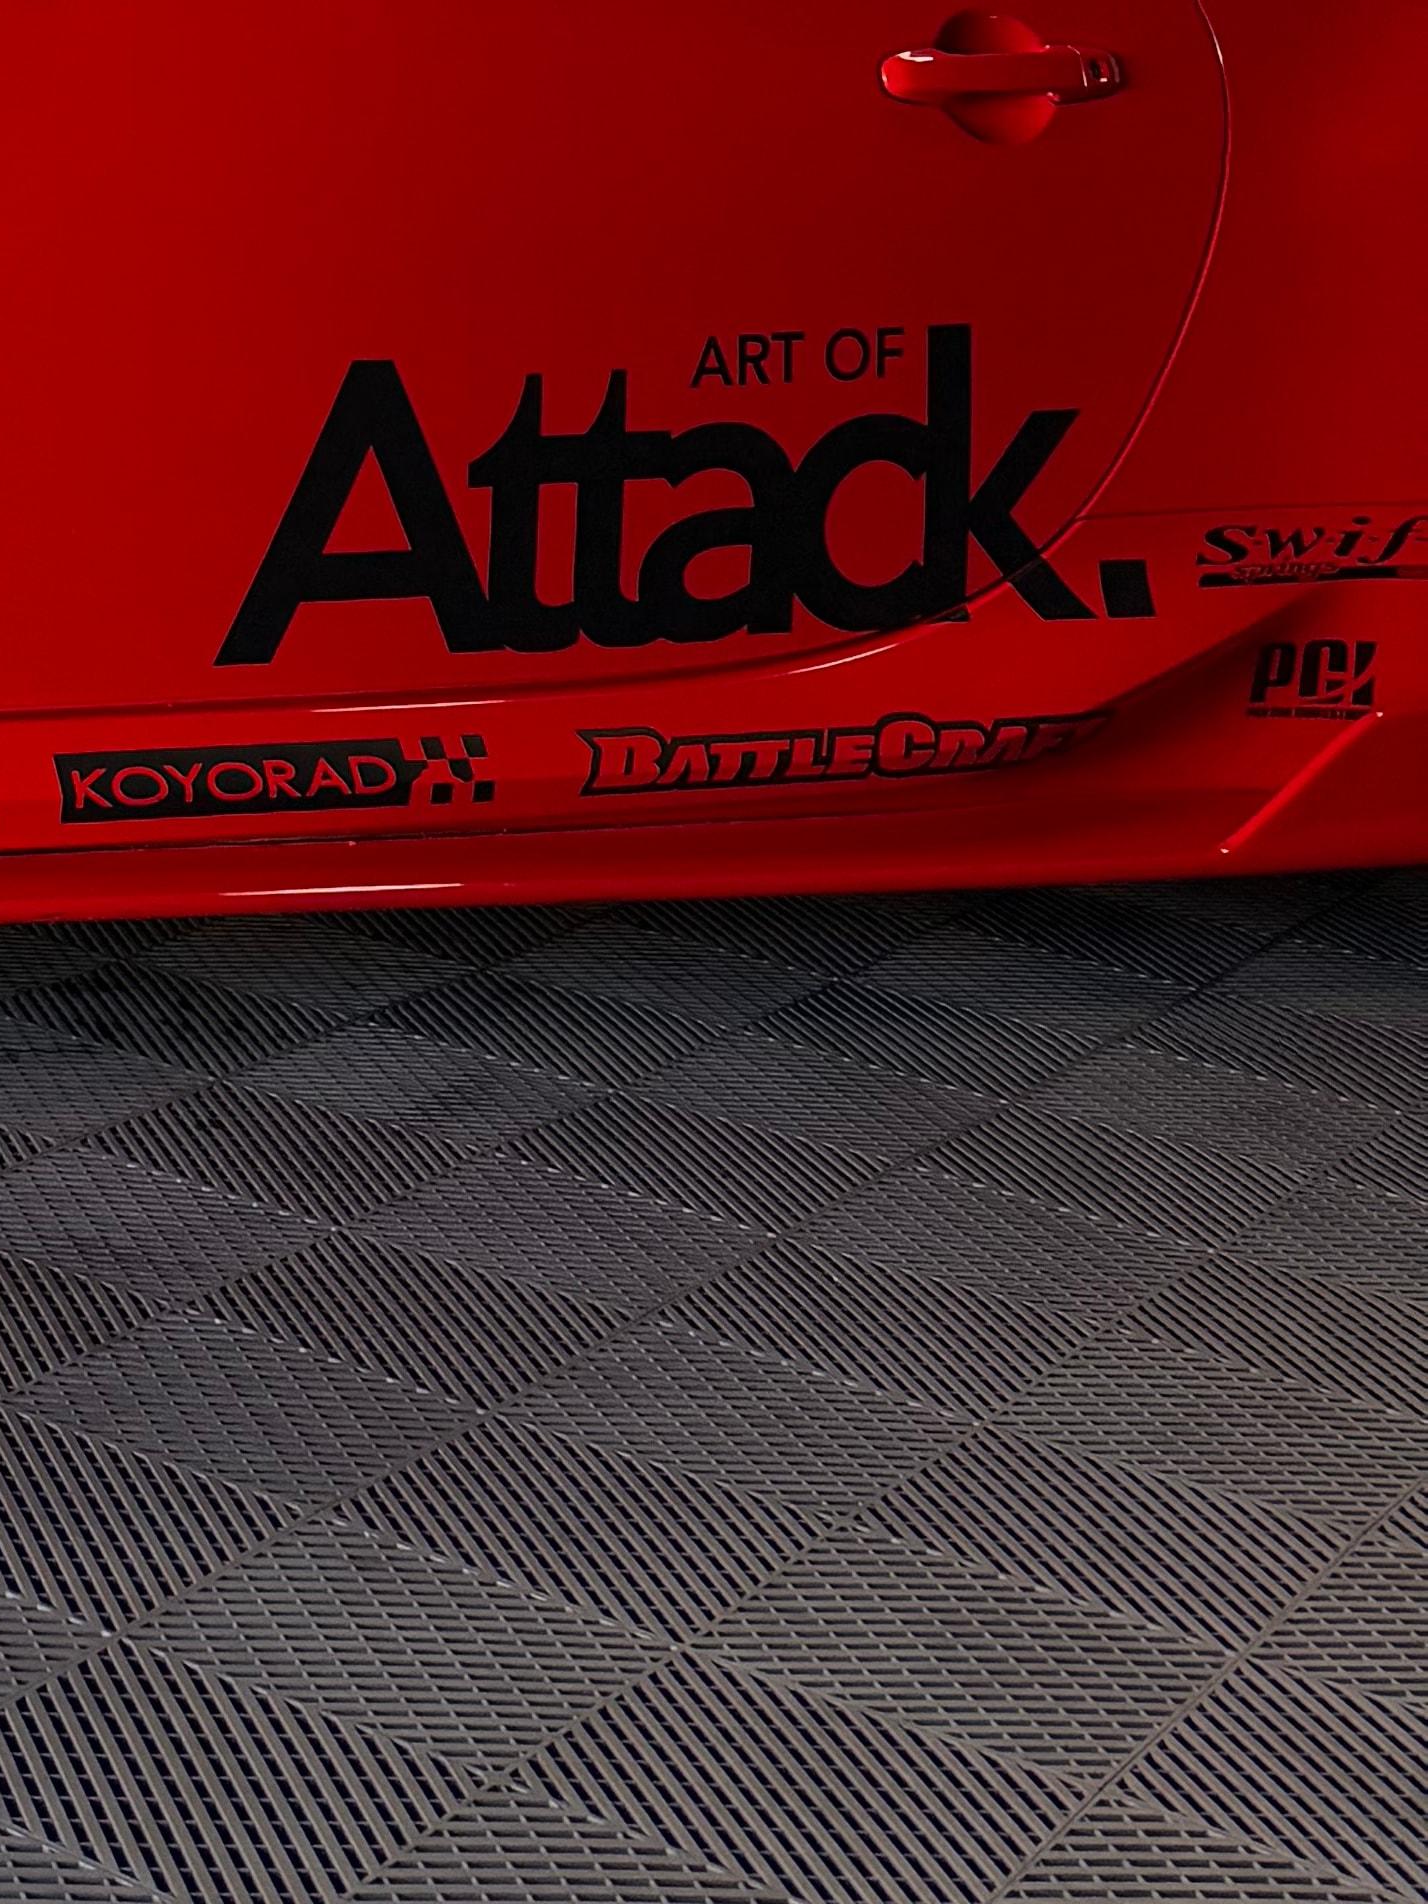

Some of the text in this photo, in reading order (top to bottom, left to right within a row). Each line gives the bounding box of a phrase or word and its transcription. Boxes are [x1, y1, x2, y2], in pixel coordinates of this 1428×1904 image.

[690, 327, 906, 389] ART OF
[212, 323, 1157, 667] Attack.
[1197, 515, 1428, 566] Swif
[68, 755, 397, 809] KOYORAD
